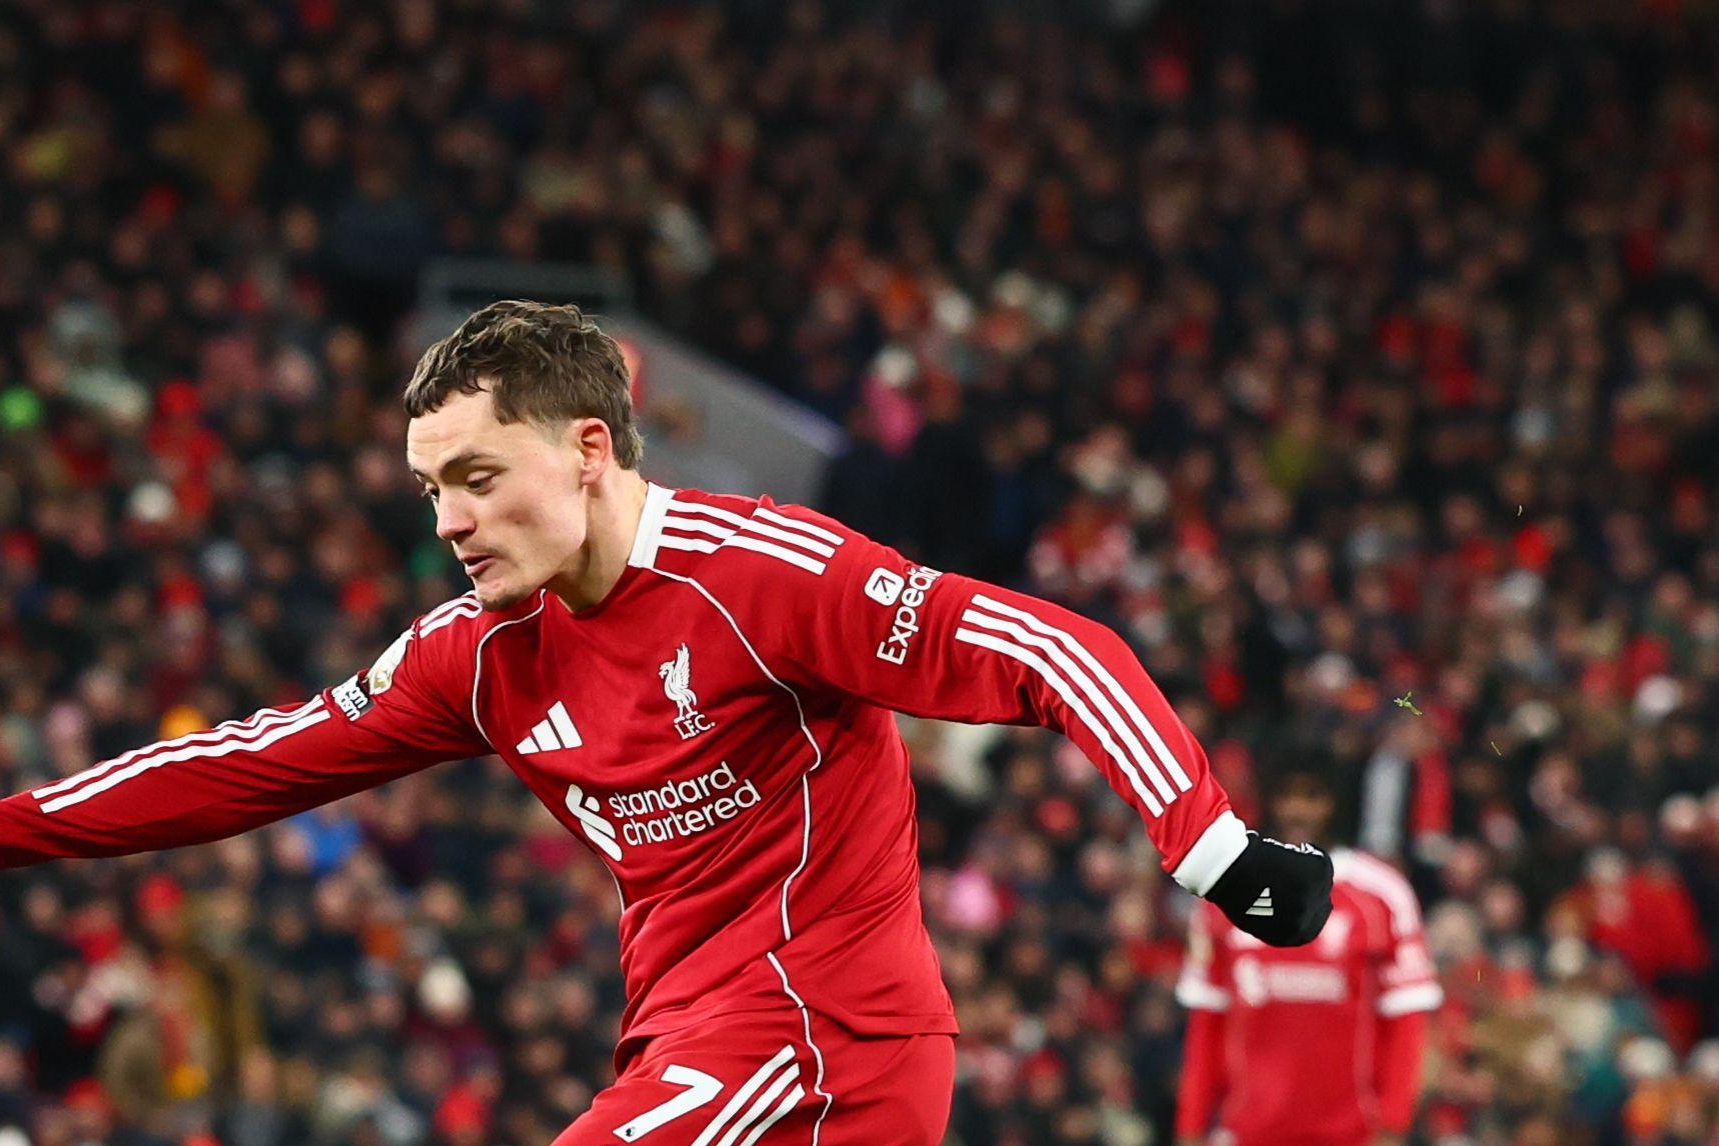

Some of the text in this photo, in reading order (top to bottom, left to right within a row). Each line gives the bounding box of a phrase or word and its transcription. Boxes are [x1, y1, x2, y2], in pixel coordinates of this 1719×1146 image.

[608, 760, 736, 818] standard
[622, 778, 761, 846] chartered
[612, 1064, 724, 1143] 7
